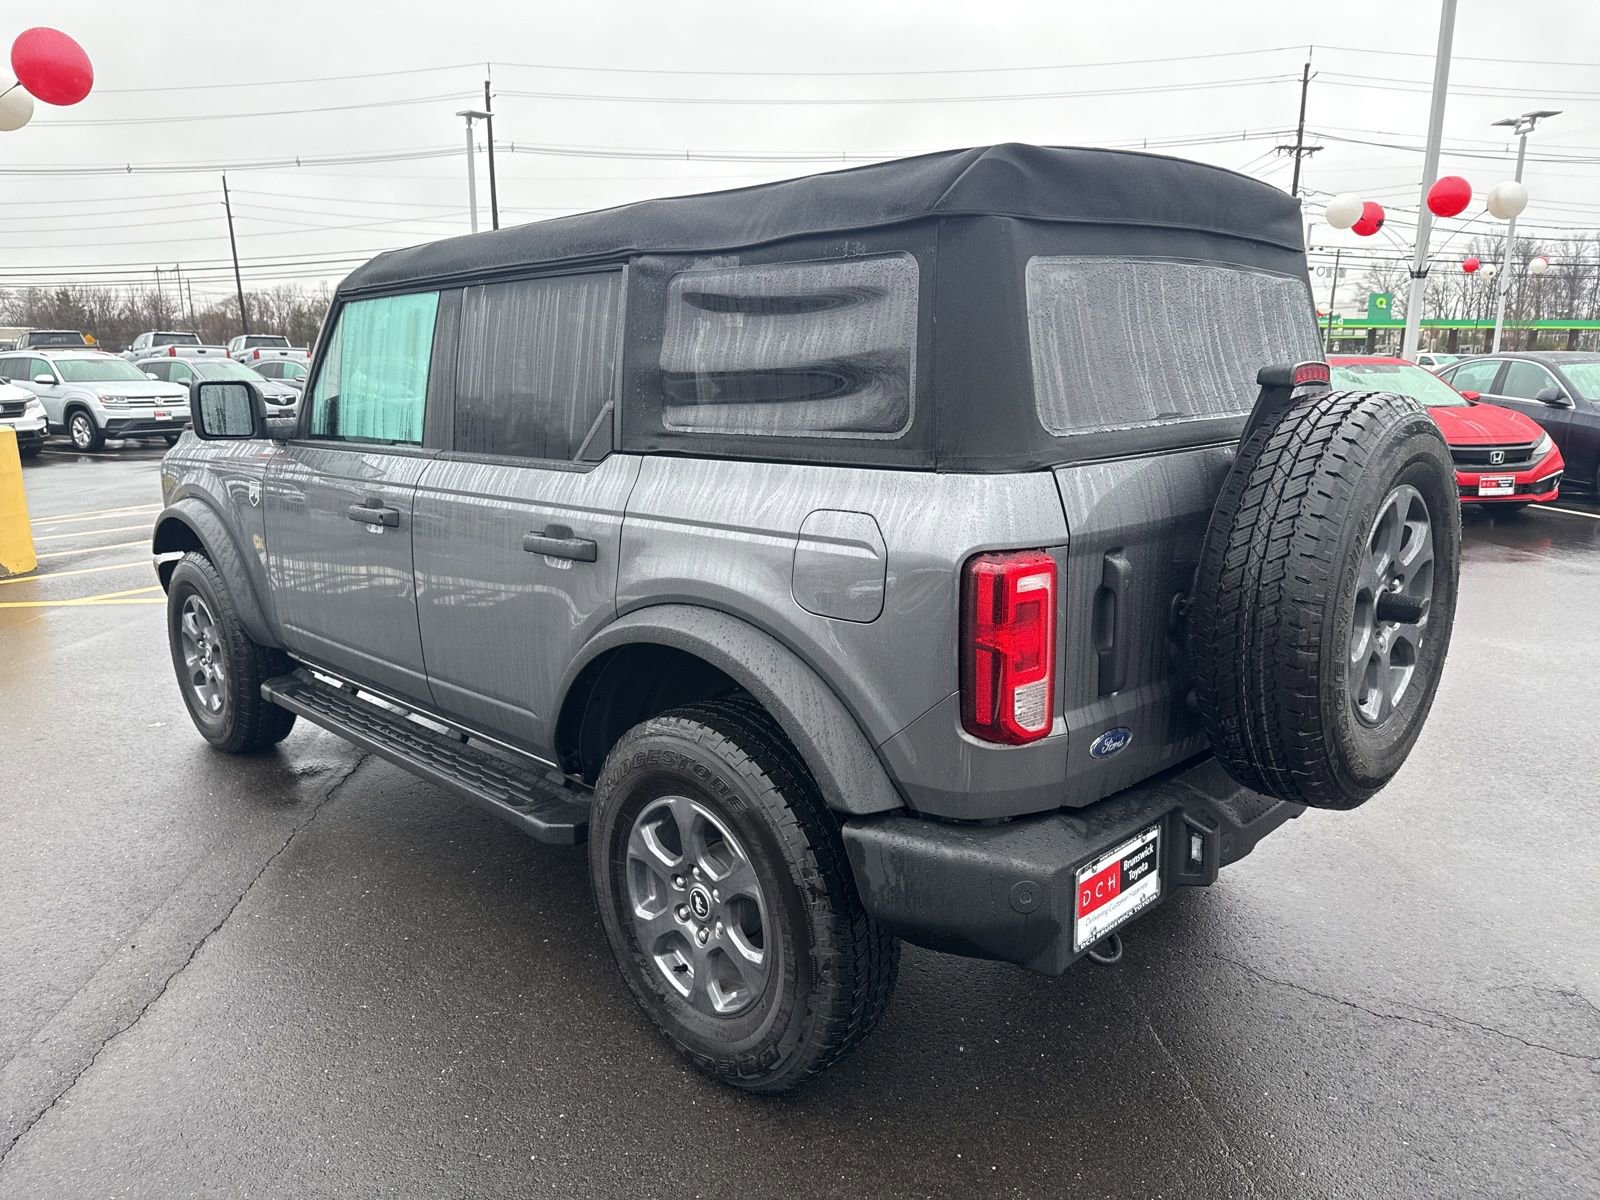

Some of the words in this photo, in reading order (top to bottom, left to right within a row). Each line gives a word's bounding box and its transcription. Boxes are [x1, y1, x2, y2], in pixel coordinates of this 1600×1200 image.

[1101, 735, 1125, 754] Ford
[1123, 843, 1154, 871] Brunswick
[1128, 861, 1149, 881] Toyota
[1082, 873, 1116, 907] DCH
[1080, 935, 1095, 950] DCH
[1096, 910, 1134, 938] BRUNSWICK
[1134, 894, 1158, 914] TOYOTA
